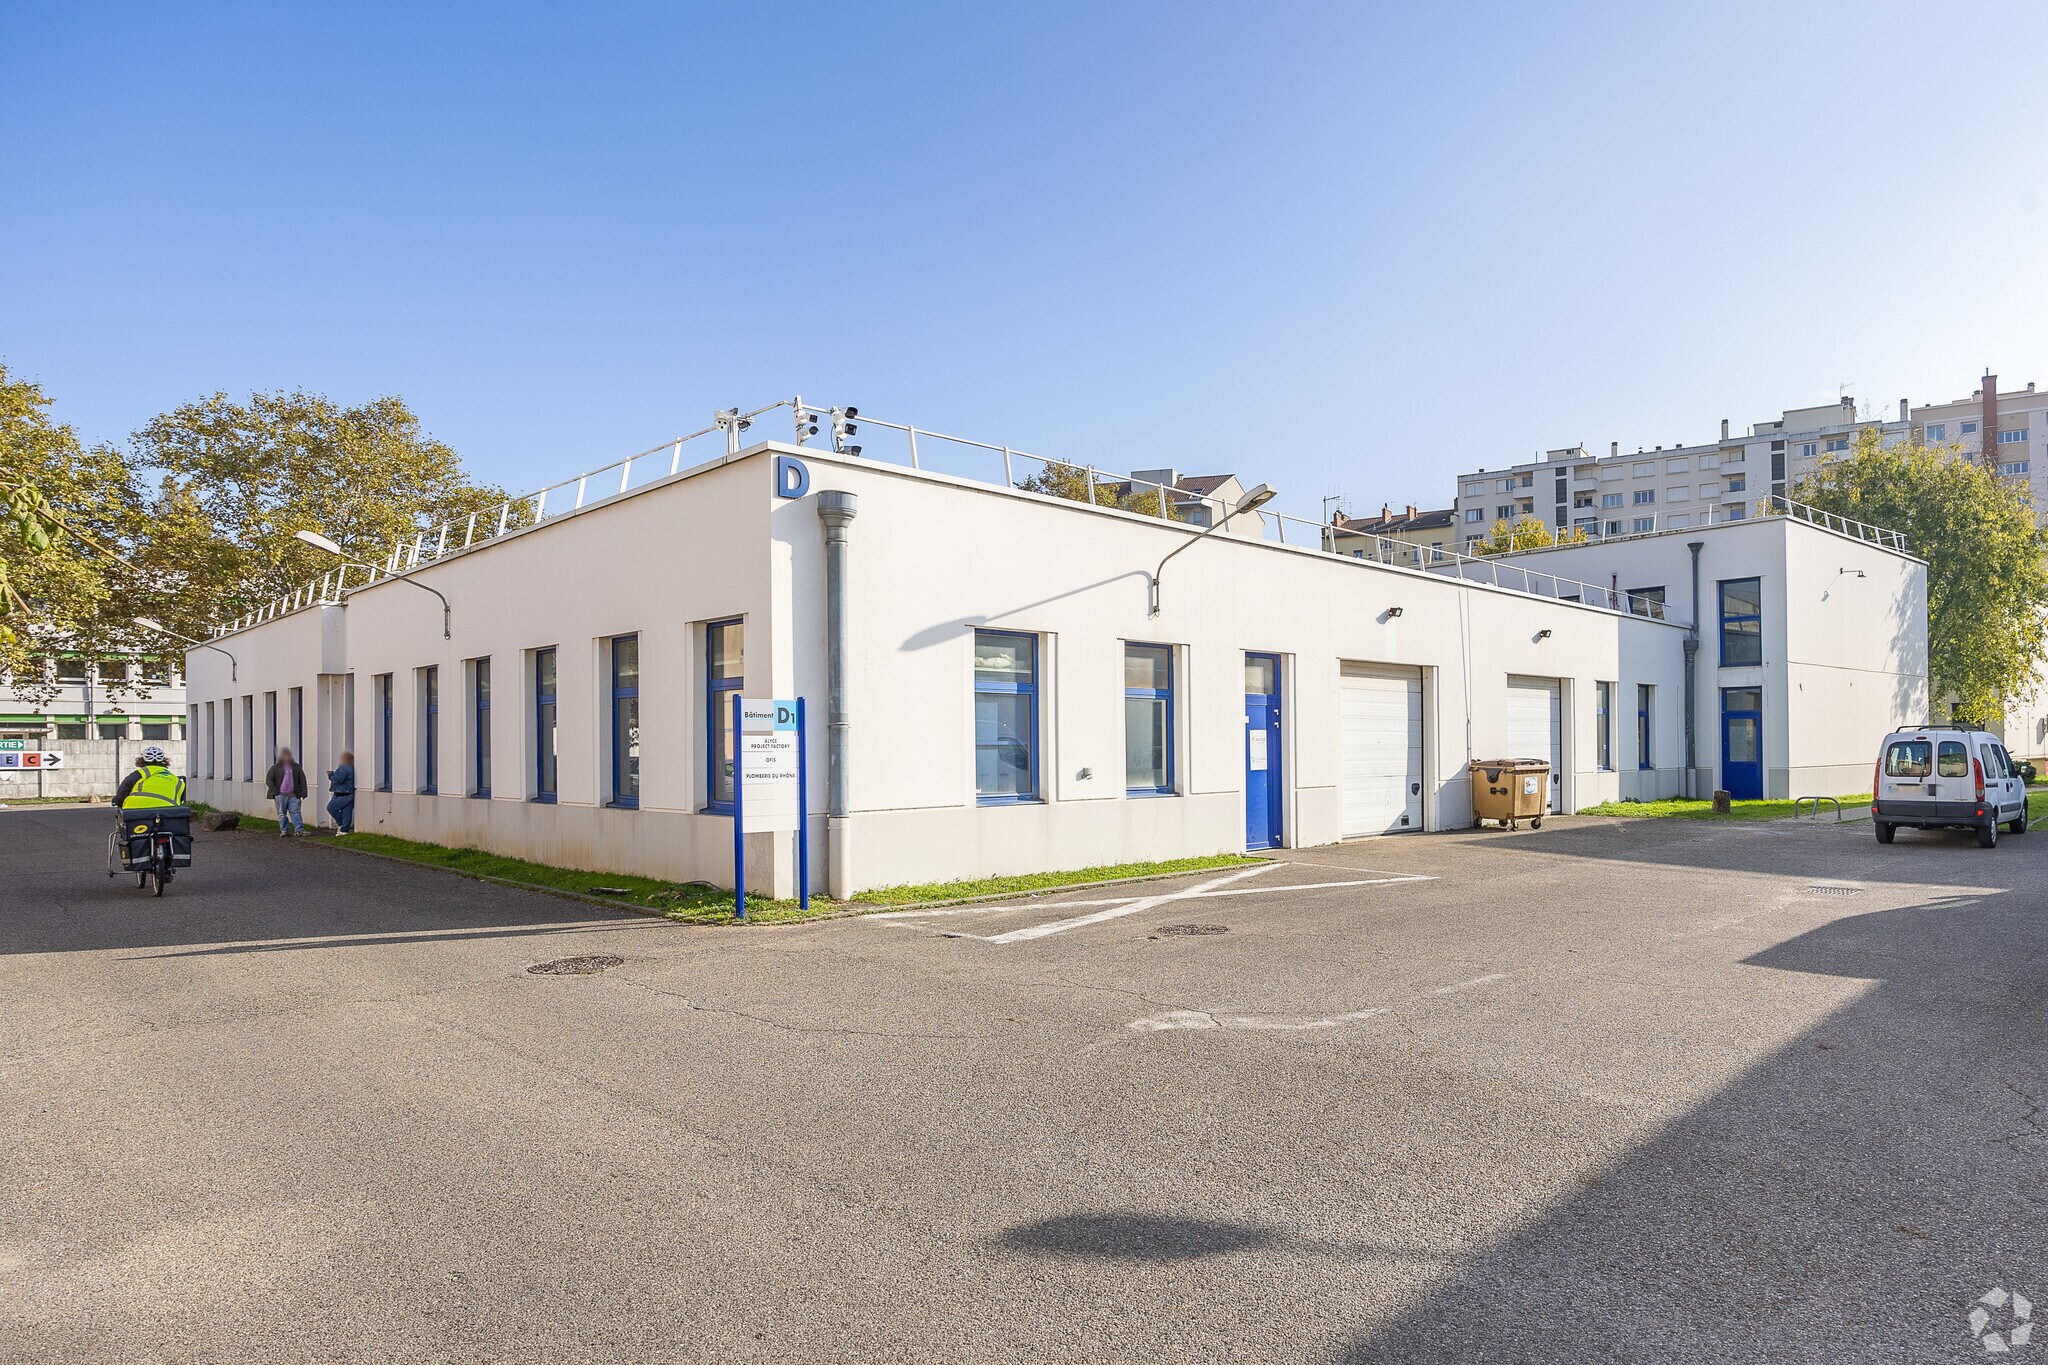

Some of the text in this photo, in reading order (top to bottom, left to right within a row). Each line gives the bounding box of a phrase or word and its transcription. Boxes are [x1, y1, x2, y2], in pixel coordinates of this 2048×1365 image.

[777, 455, 811, 500] D
[744, 707, 795, 724] Bâtiment D1
[5, 755, 37, 765] E C
